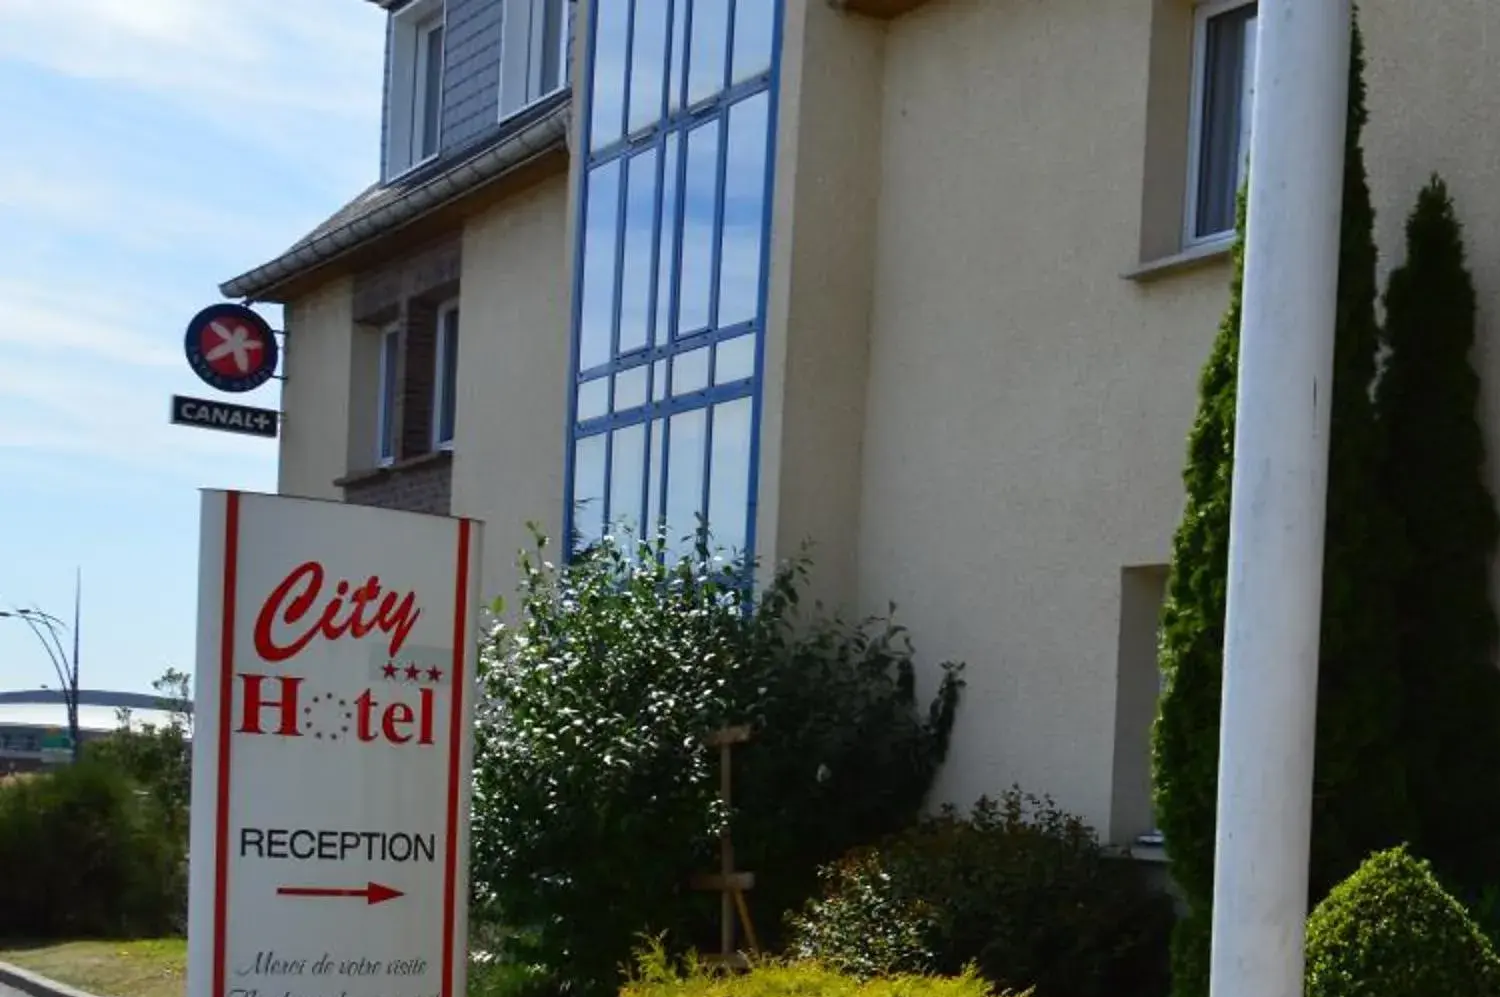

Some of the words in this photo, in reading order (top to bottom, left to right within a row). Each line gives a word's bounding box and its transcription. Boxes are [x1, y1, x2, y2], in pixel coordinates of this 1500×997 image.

[181, 402, 271, 431] CANAL+
[253, 560, 422, 663] City
[233, 673, 435, 745] Hotel
[240, 828, 435, 862] RECEPTION
[235, 952, 307, 977] Merci
[311, 953, 335, 976] de
[338, 956, 383, 976] votre
[386, 956, 428, 977] visite
